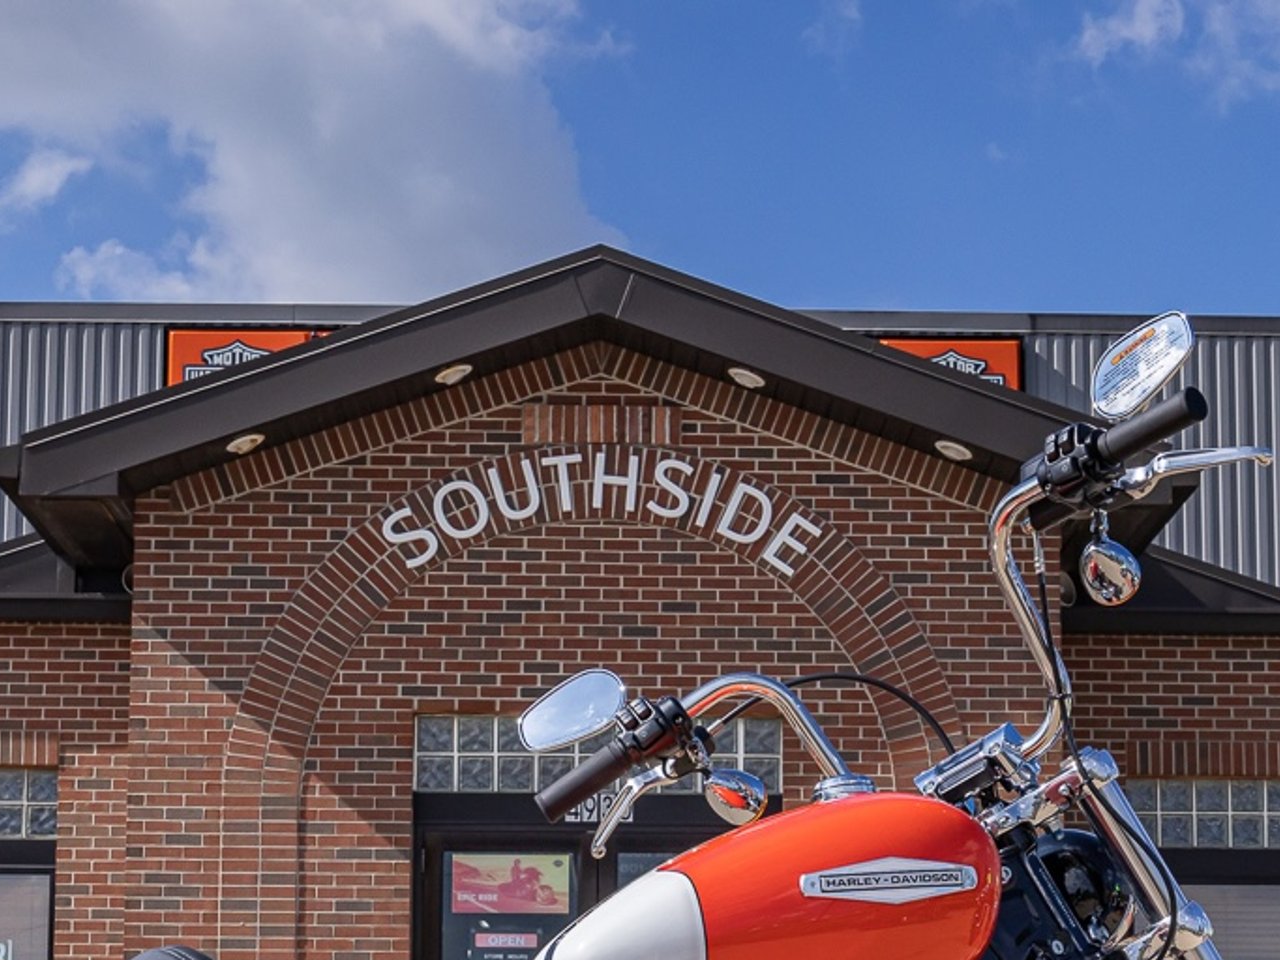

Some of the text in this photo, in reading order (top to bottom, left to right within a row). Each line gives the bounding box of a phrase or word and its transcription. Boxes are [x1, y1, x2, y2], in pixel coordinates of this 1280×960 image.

[382, 453, 822, 577] SOUTHSIDE
[825, 872, 961, 888] HARLEY-DAVIDSON
[488, 934, 526, 946] OPEN
